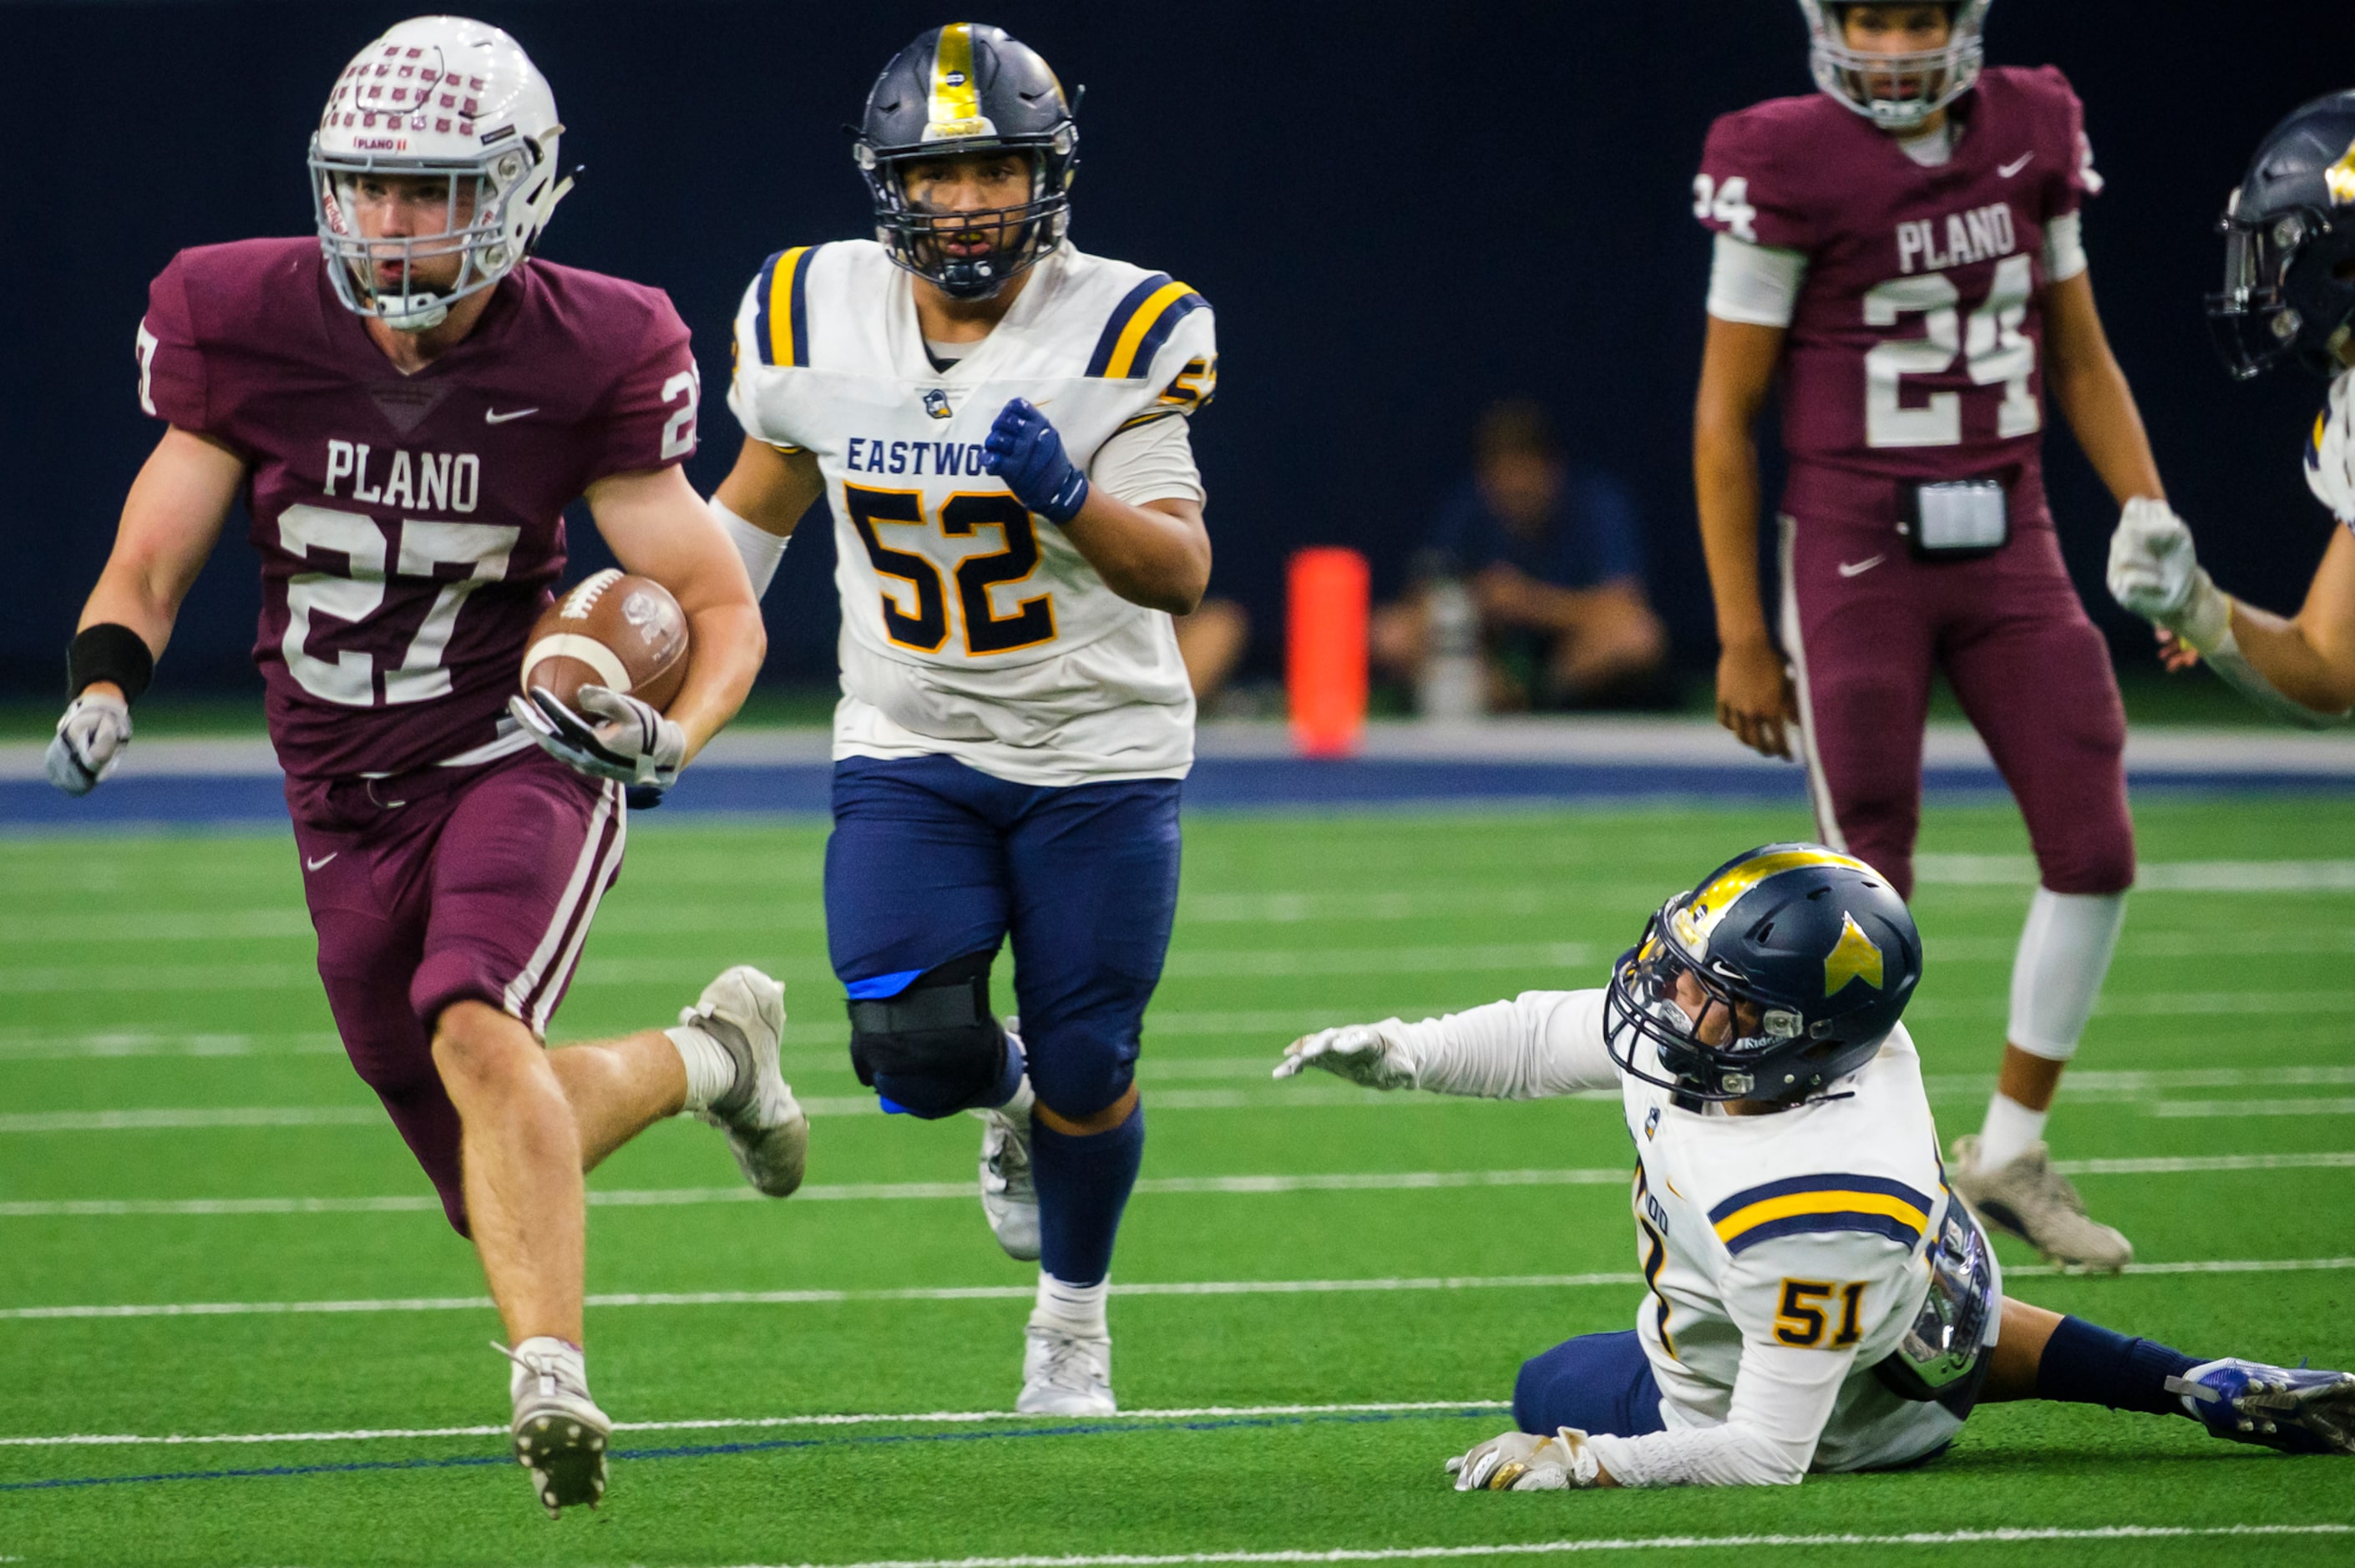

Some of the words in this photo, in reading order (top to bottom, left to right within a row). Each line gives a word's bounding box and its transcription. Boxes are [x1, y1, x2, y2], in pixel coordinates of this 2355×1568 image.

[357, 139, 393, 150] PLANO
[1896, 202, 2016, 274] PLANO
[1863, 252, 2040, 448] 24
[661, 357, 701, 460] 2
[323, 438, 480, 513] PLANO
[277, 503, 521, 707] 27
[842, 478, 1058, 657] 52
[1772, 1277, 1868, 1351] 51
